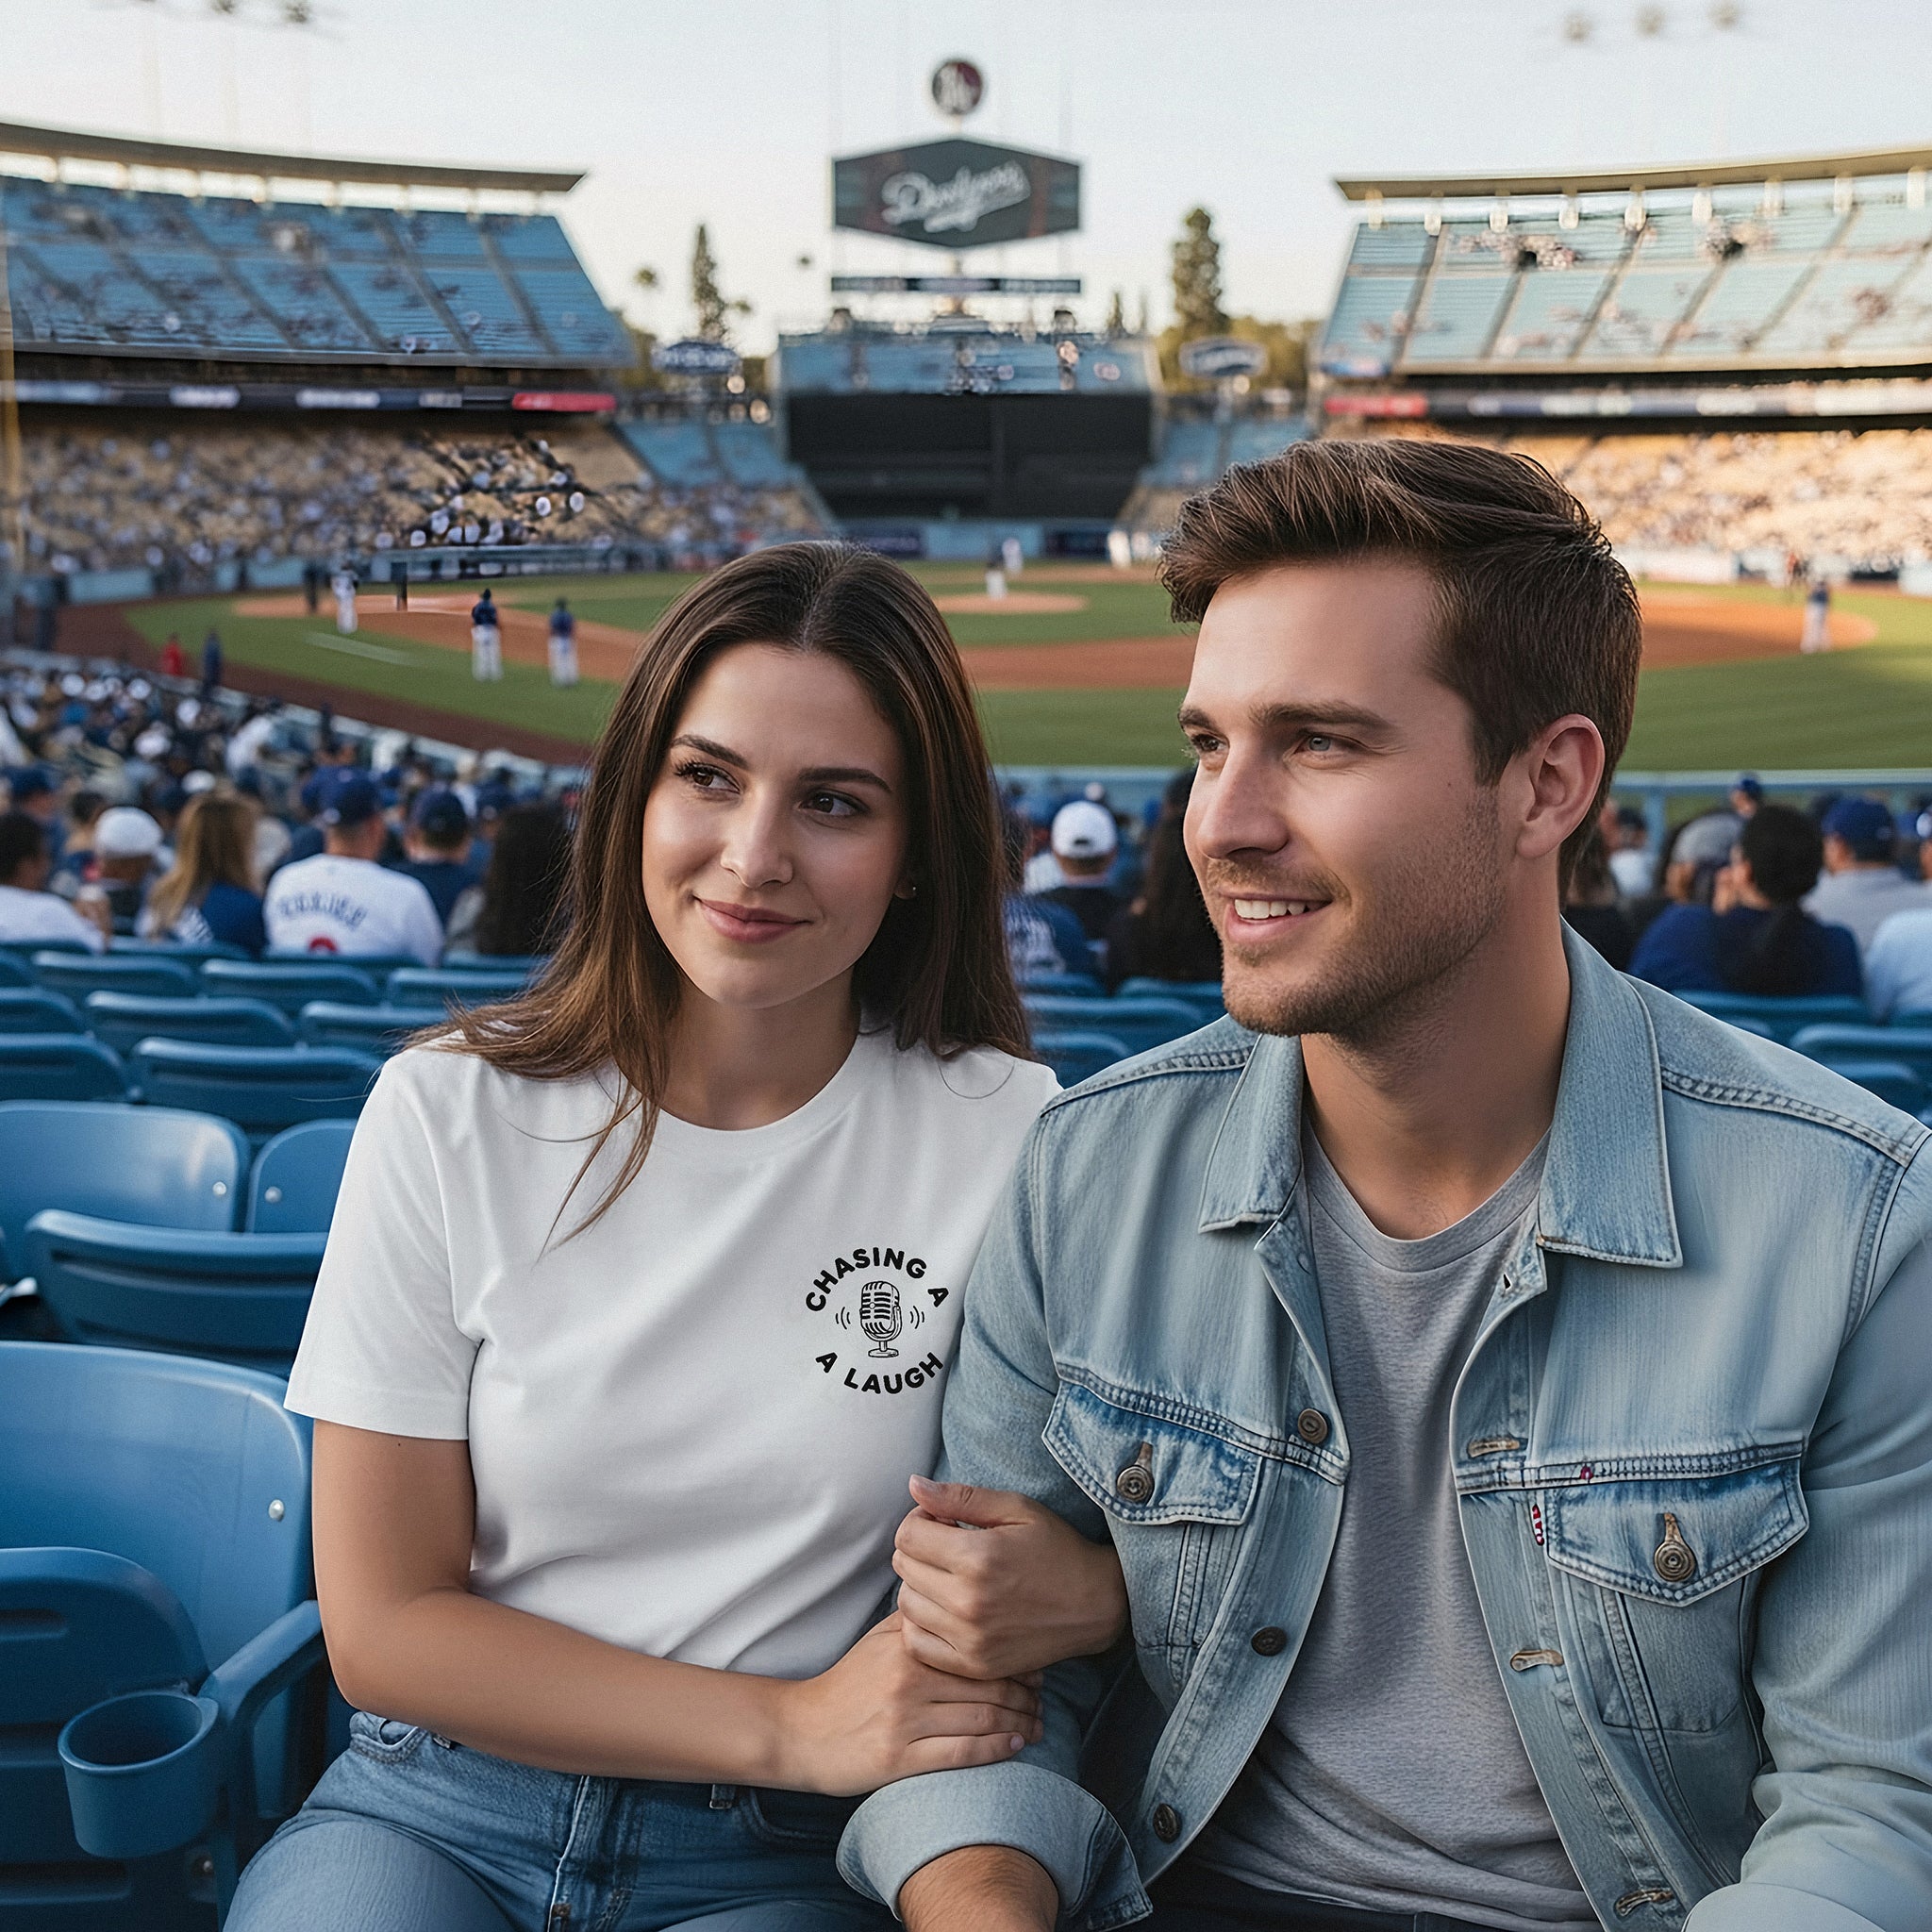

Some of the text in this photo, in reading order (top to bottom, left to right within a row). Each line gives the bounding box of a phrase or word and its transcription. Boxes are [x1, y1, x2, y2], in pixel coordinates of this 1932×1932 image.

[806, 1247, 949, 1311] CHASING A
[815, 1352, 943, 1394] A LAUGH
